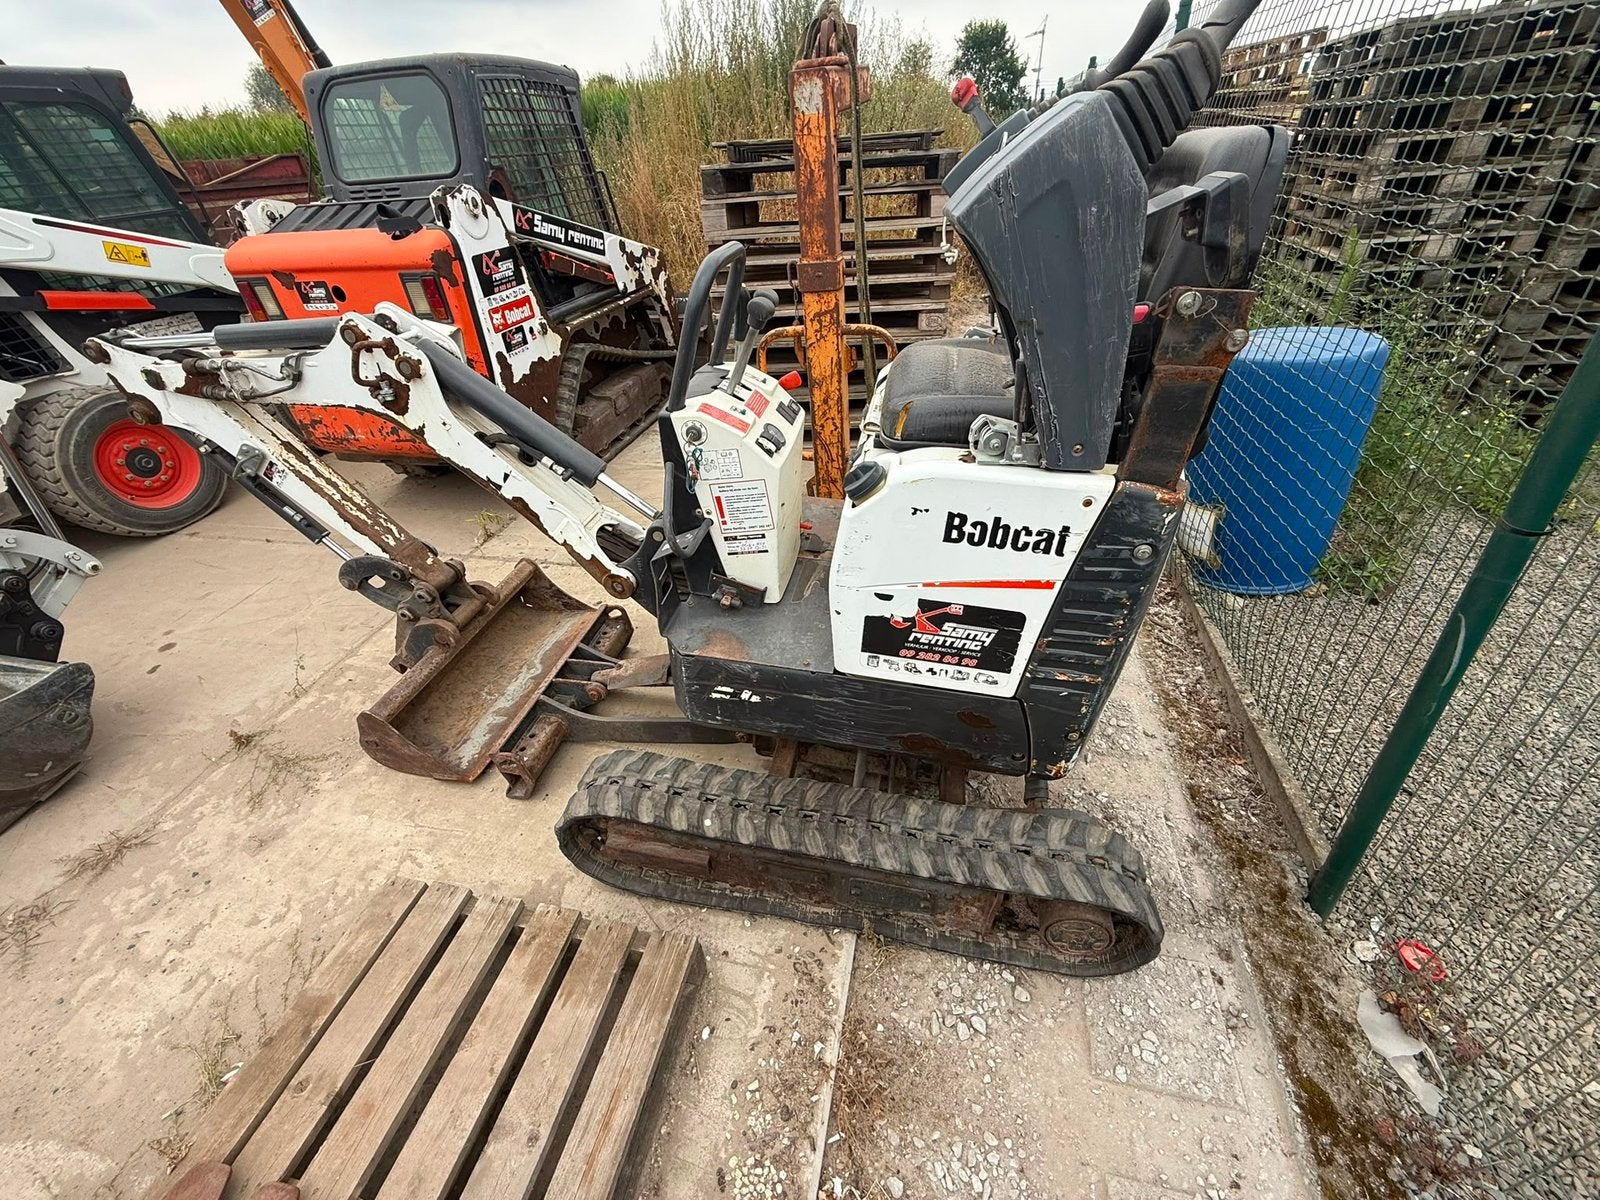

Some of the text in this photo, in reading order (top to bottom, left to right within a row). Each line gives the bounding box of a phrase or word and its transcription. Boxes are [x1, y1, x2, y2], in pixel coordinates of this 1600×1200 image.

[533, 213, 565, 243] Samy
[504, 302, 532, 325] Bobcat
[942, 511, 1071, 558] Bobcat
[939, 622, 996, 647] Samy
[899, 648, 978, 667] 09 282 86 98
